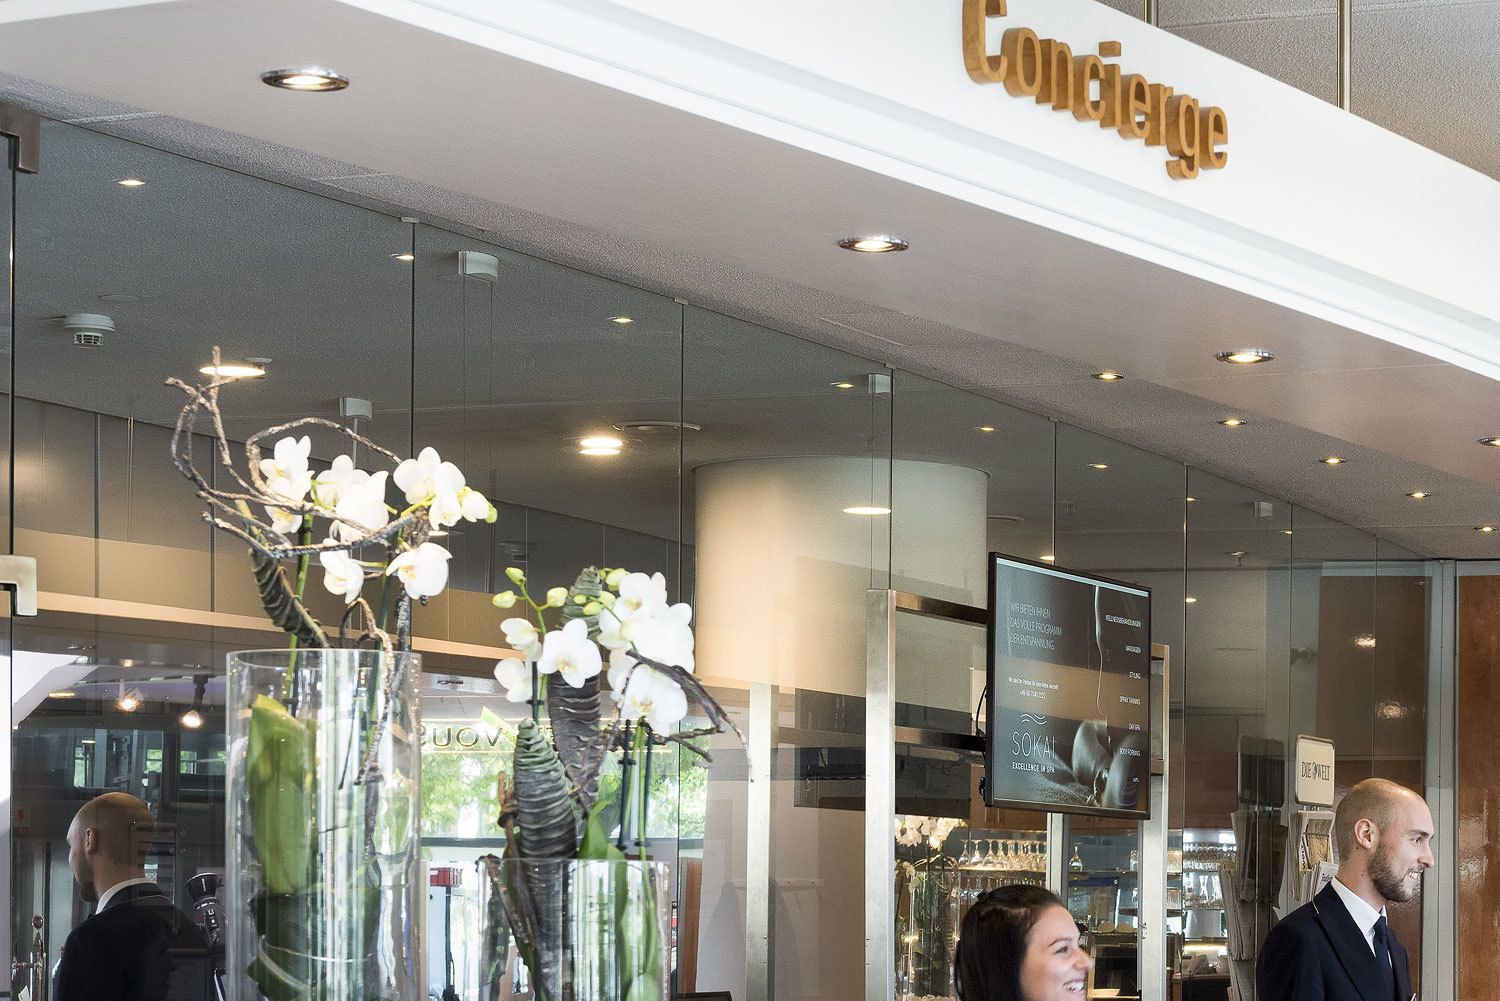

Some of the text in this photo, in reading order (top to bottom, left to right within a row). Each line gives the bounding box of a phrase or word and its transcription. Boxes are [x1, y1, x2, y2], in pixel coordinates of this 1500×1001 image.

[962, 0, 1229, 181] Concierge
[1012, 731, 1055, 759] SOKAI
[1012, 762, 1040, 772] EXCELLENCE
[1301, 762, 1330, 781] DIE WELT
